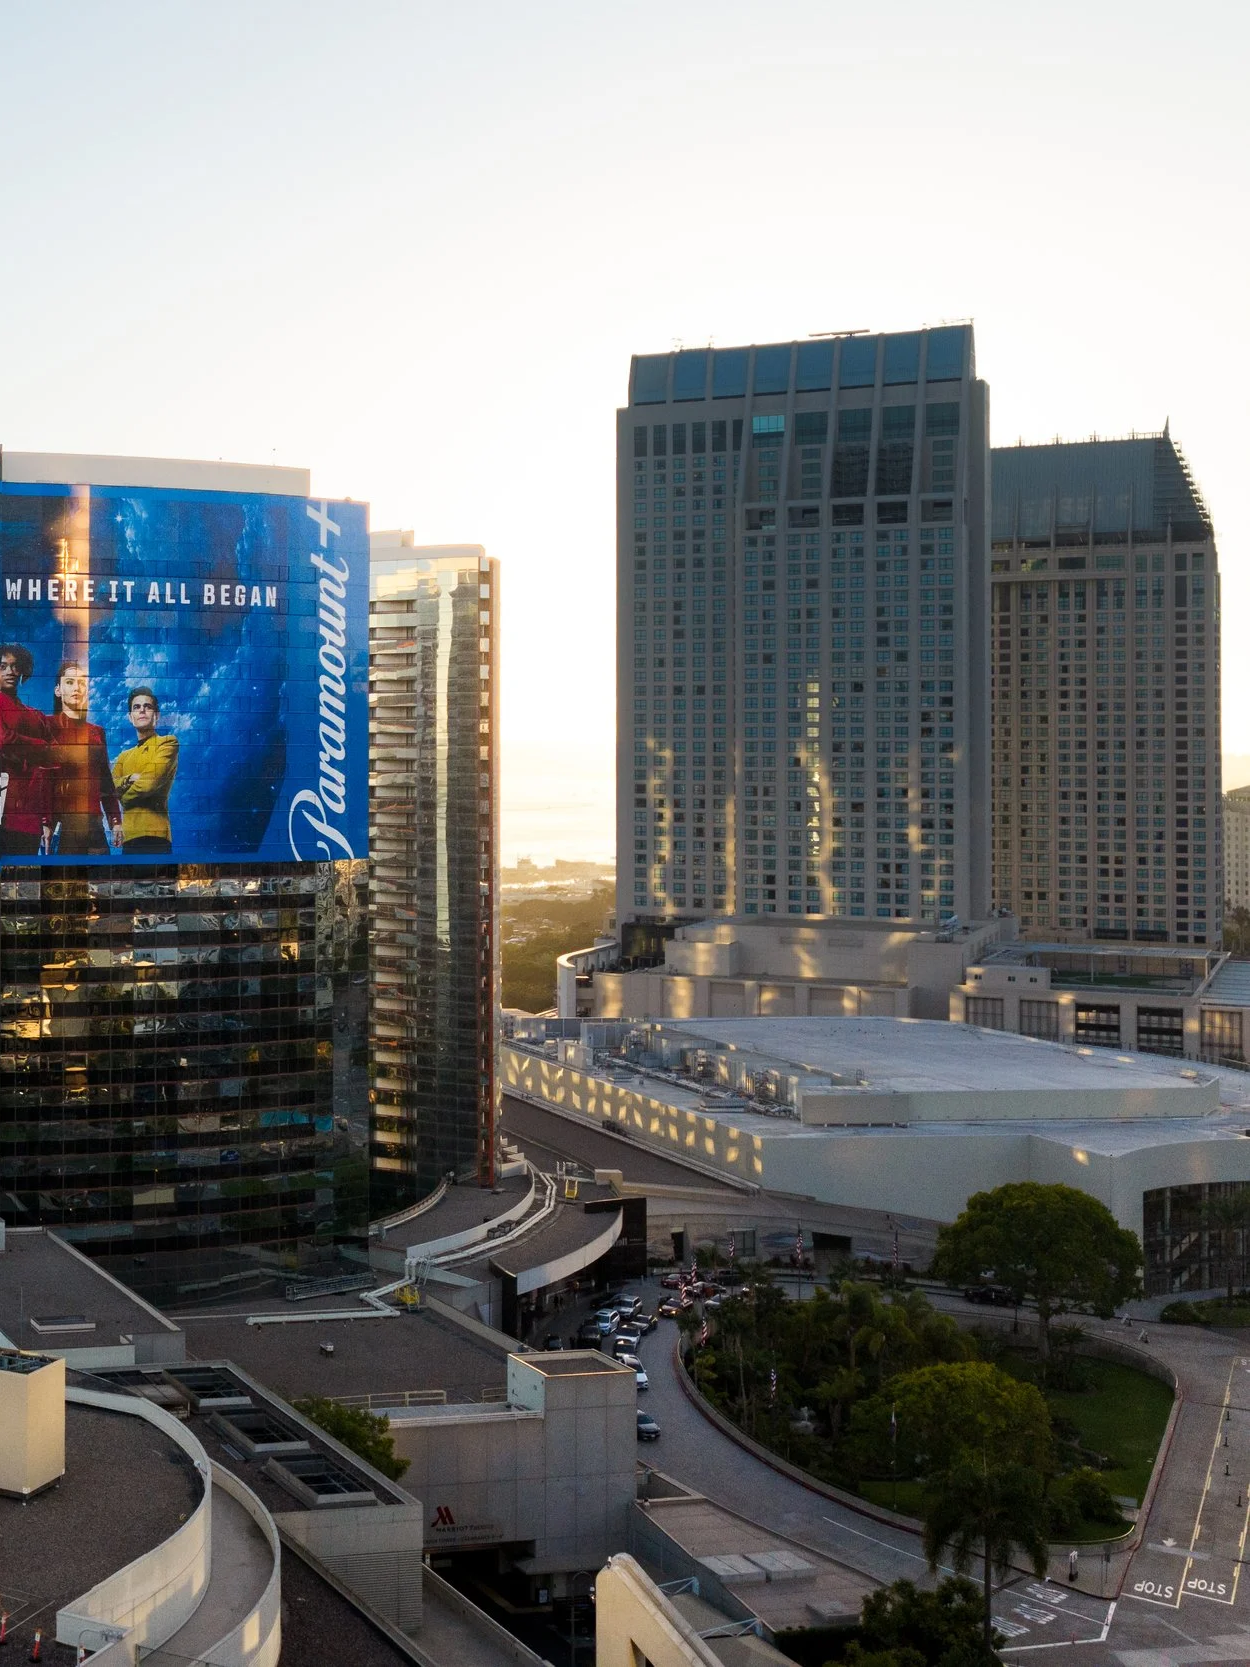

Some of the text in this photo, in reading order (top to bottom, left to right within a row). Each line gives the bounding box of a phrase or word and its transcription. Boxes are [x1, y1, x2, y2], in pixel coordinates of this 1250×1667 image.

[6, 578, 278, 608] WHERE IT ALL BEGAN
[1134, 1580, 1174, 1599] STOP
[1187, 1578, 1227, 1596] STOP
